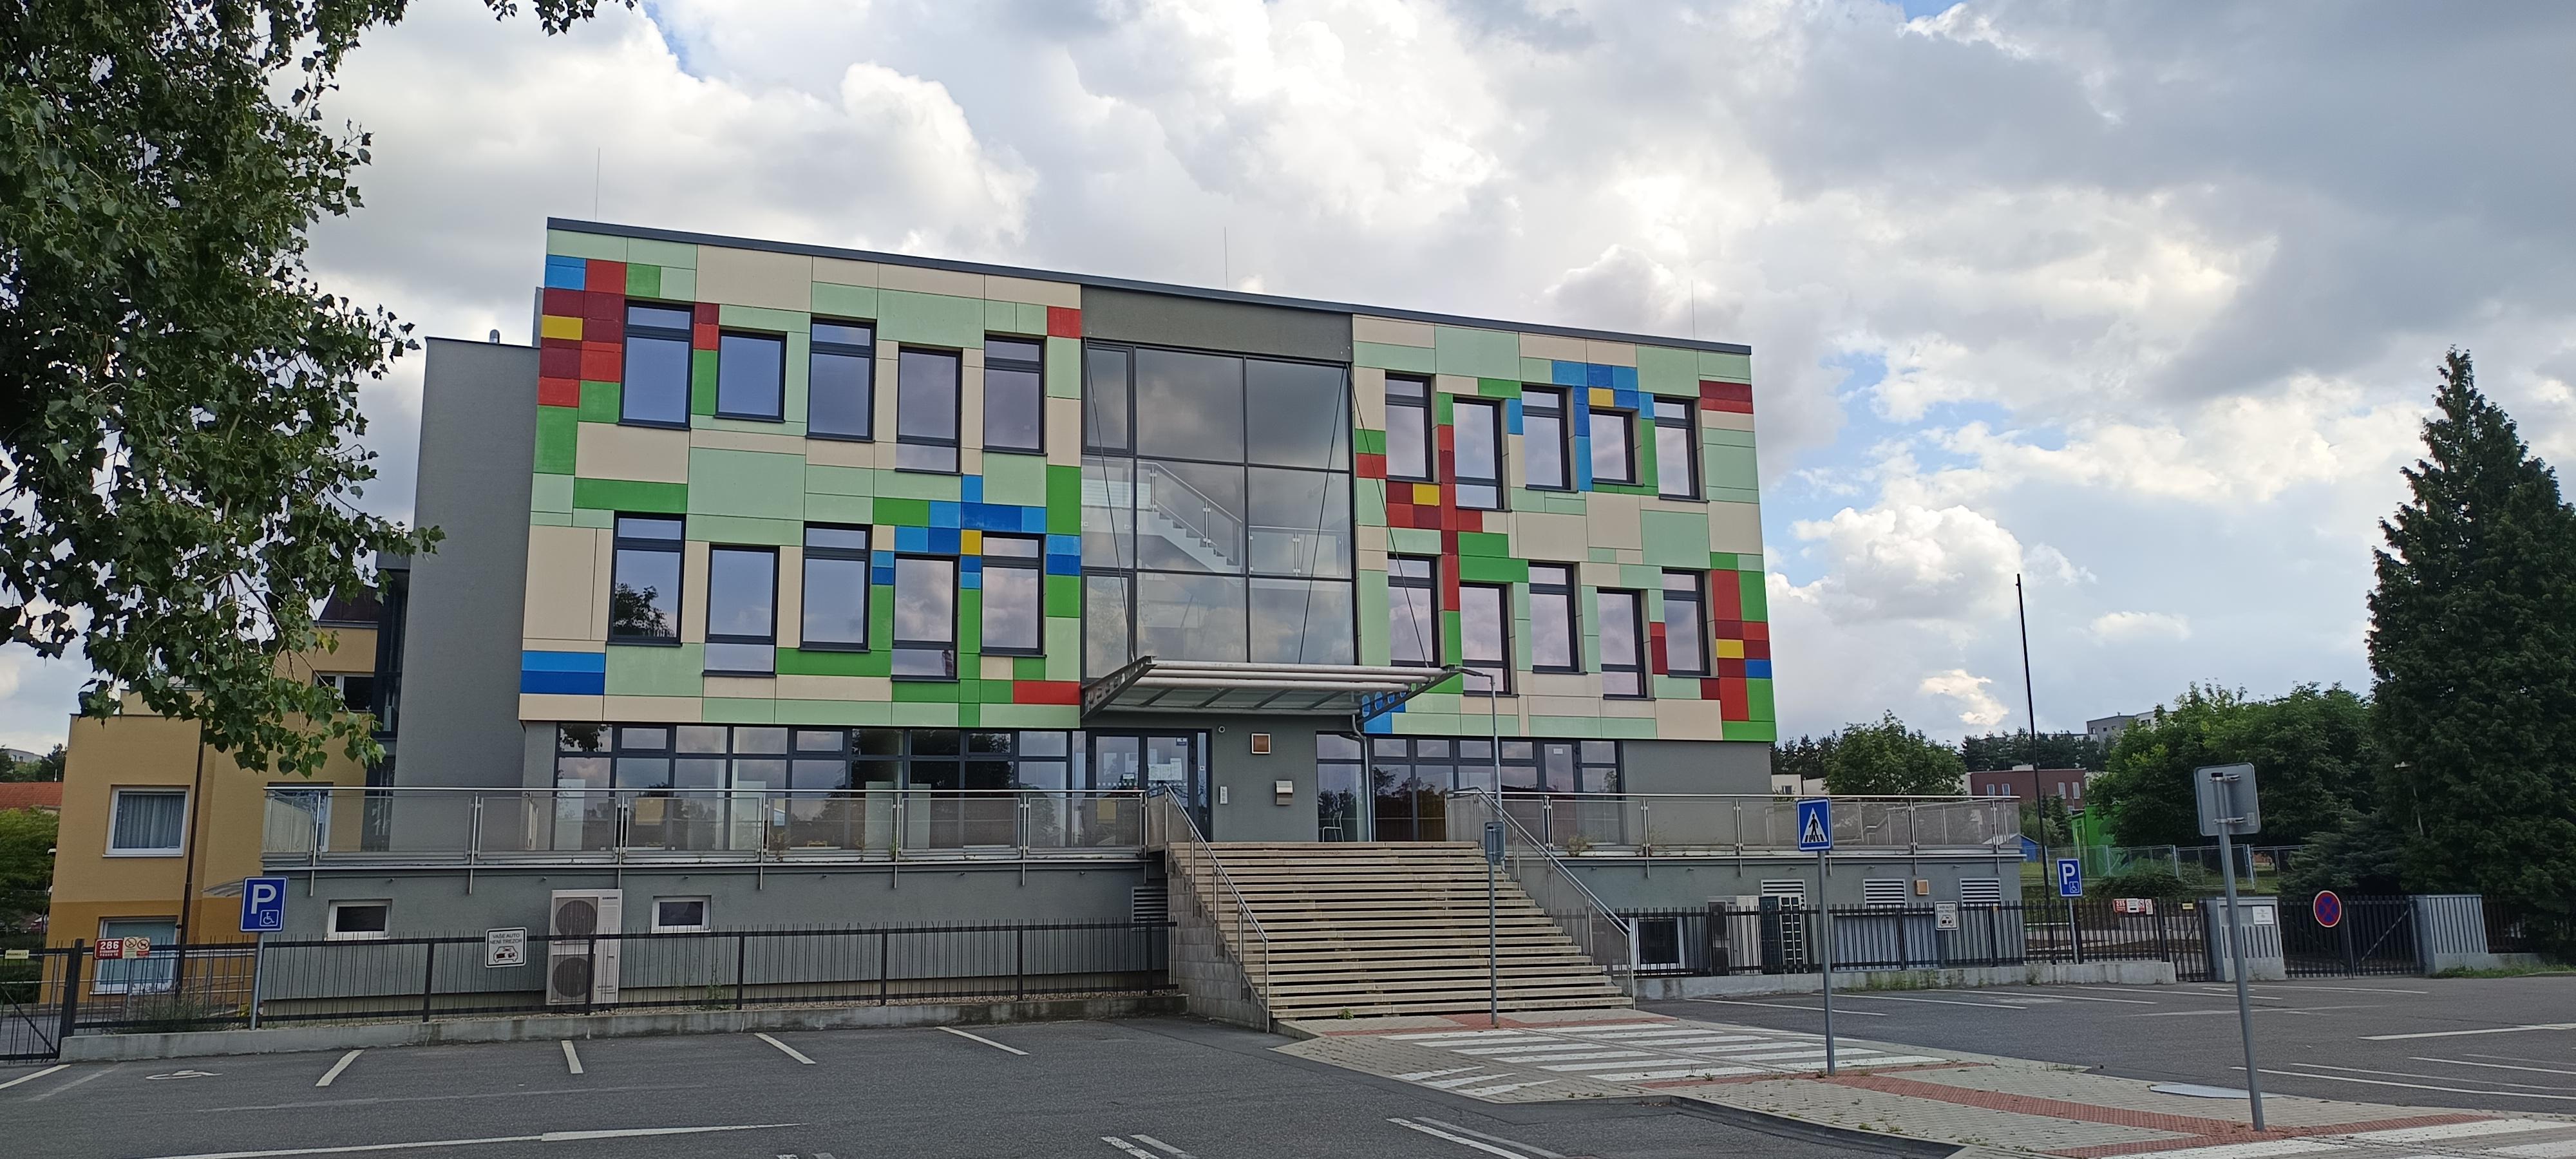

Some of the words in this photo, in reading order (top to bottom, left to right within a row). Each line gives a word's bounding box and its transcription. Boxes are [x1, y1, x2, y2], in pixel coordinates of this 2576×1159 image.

[2062, 863, 2075, 885] P
[251, 884, 276, 914] P
[100, 941, 119, 950] 286
